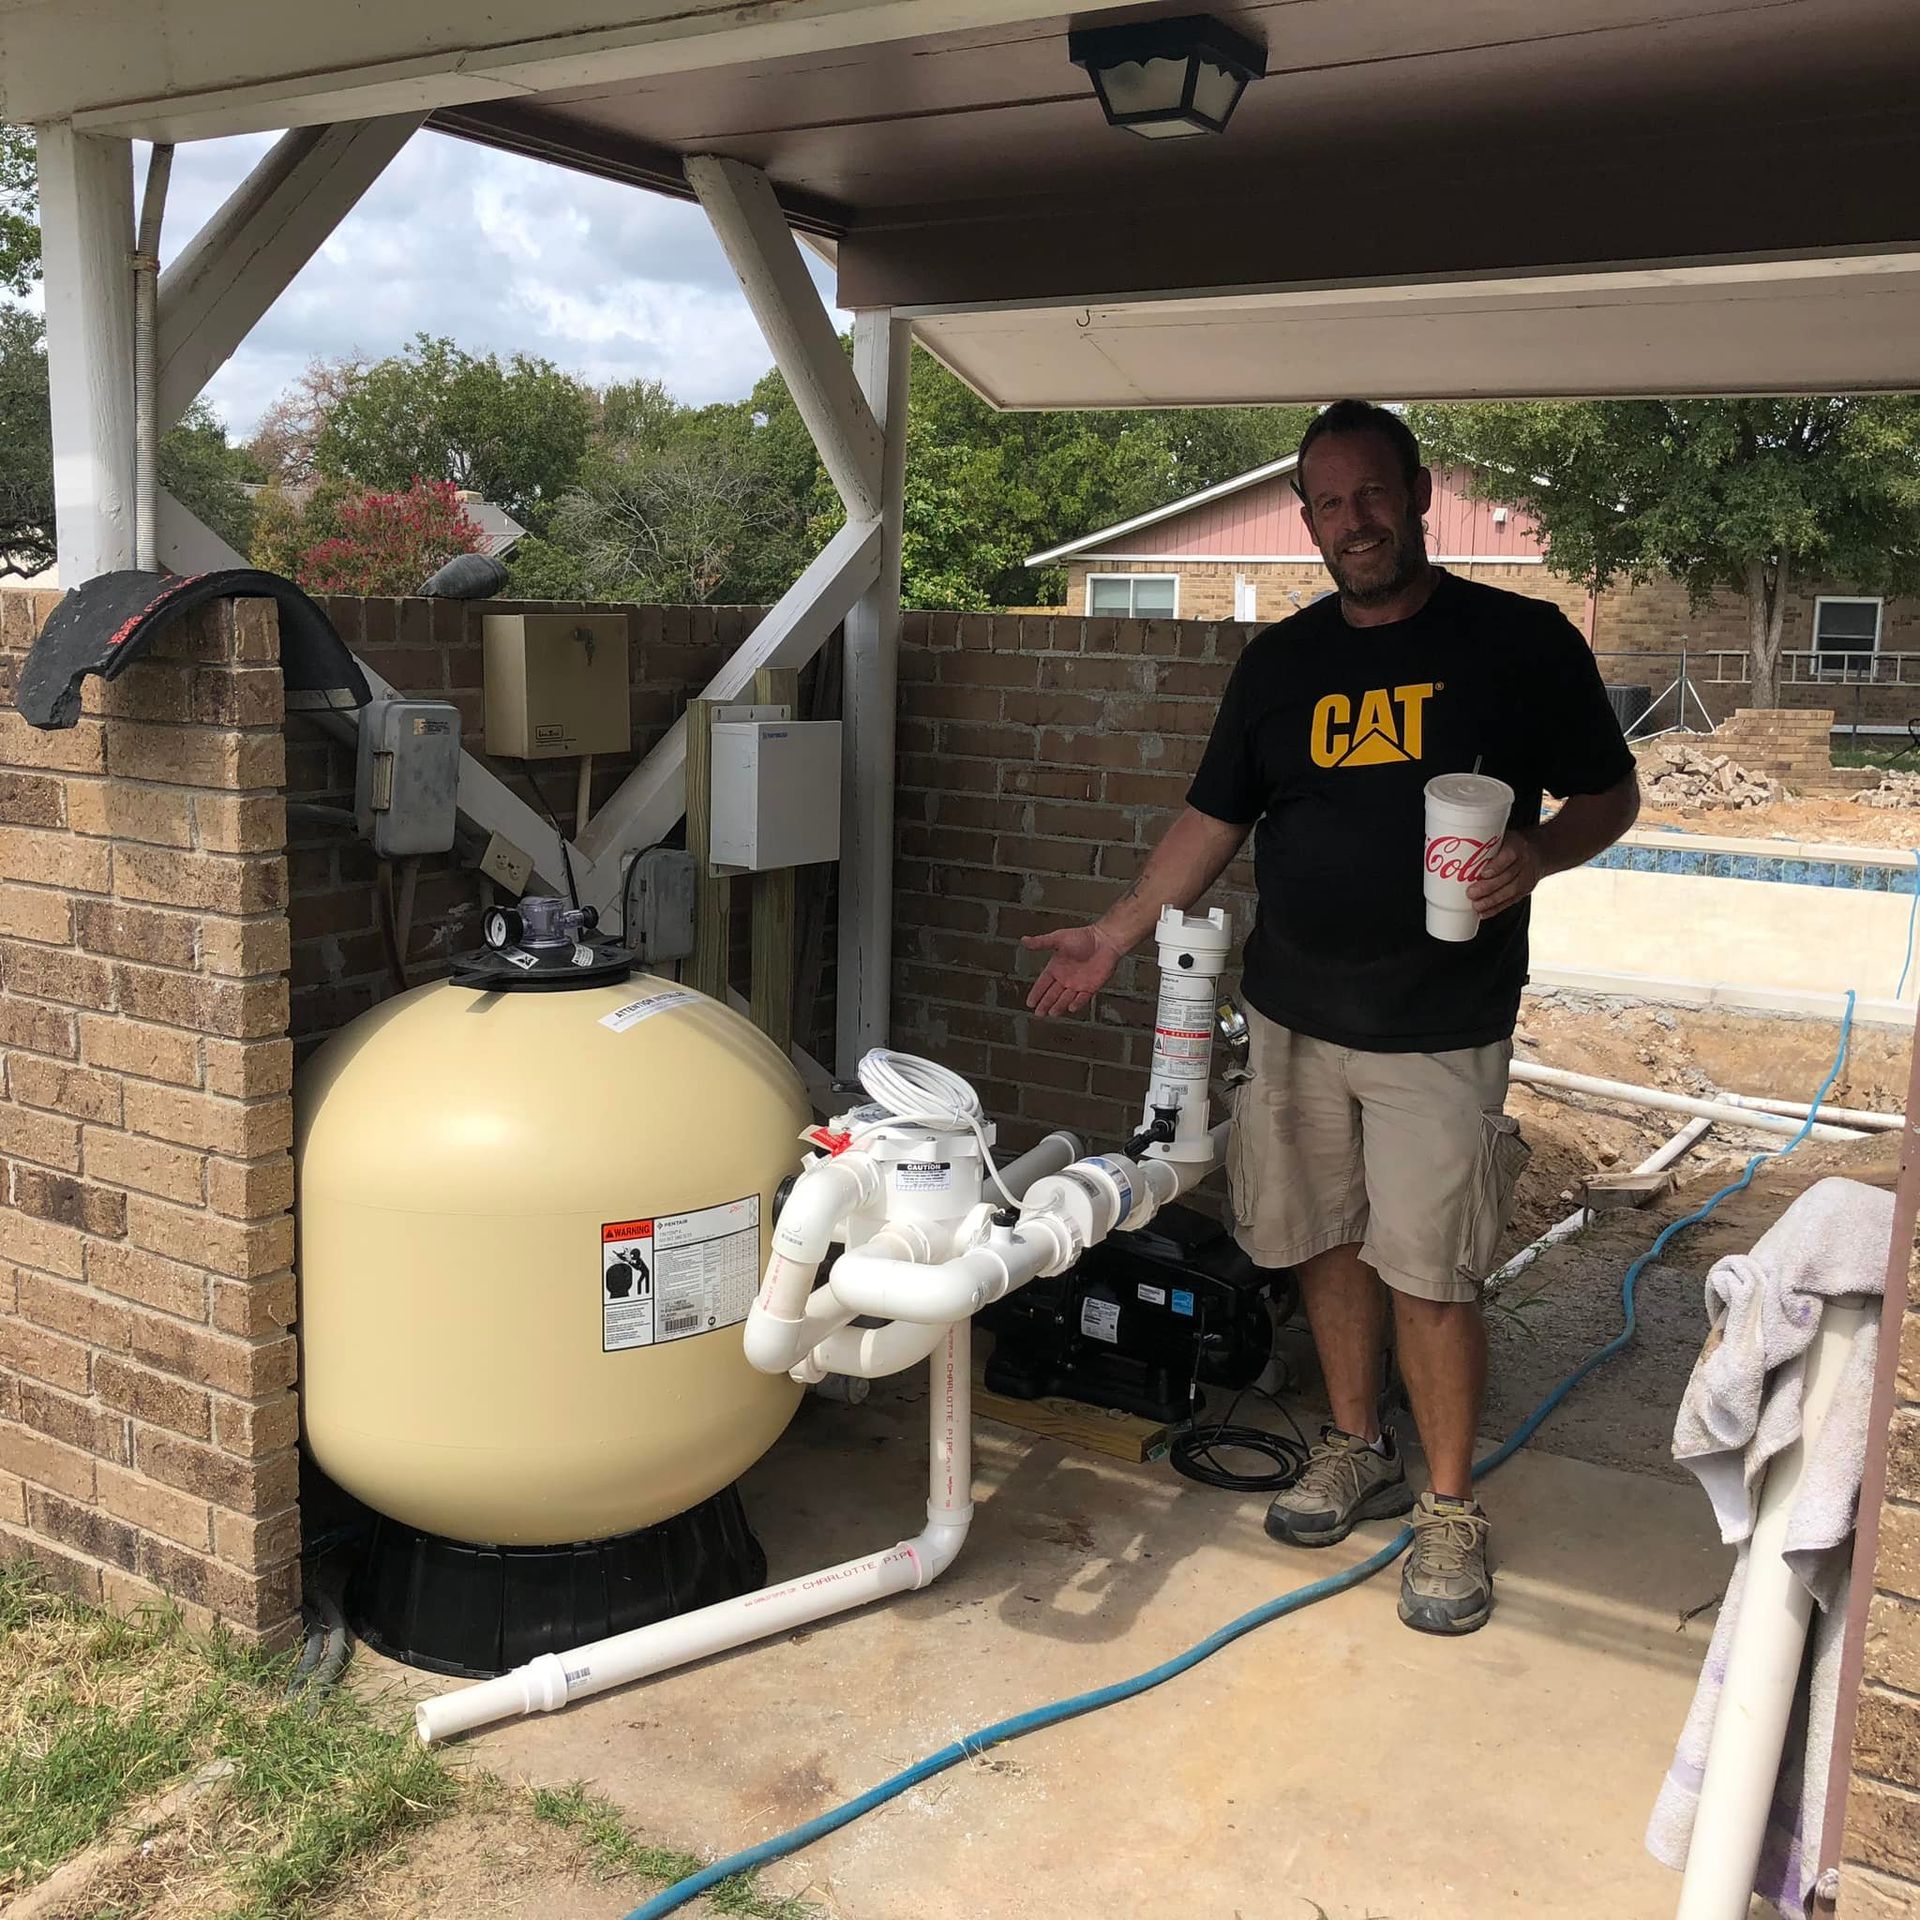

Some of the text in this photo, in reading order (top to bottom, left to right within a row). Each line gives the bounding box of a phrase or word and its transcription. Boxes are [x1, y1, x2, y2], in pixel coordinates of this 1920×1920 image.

[614, 996, 655, 1019] ATTENTION
[614, 1225, 651, 1237] WARNING
[664, 1219, 688, 1228] PENTAIR
[946, 1363, 955, 1423] CHARLOTTE
[802, 1562, 877, 1591] CHARLOTTE
